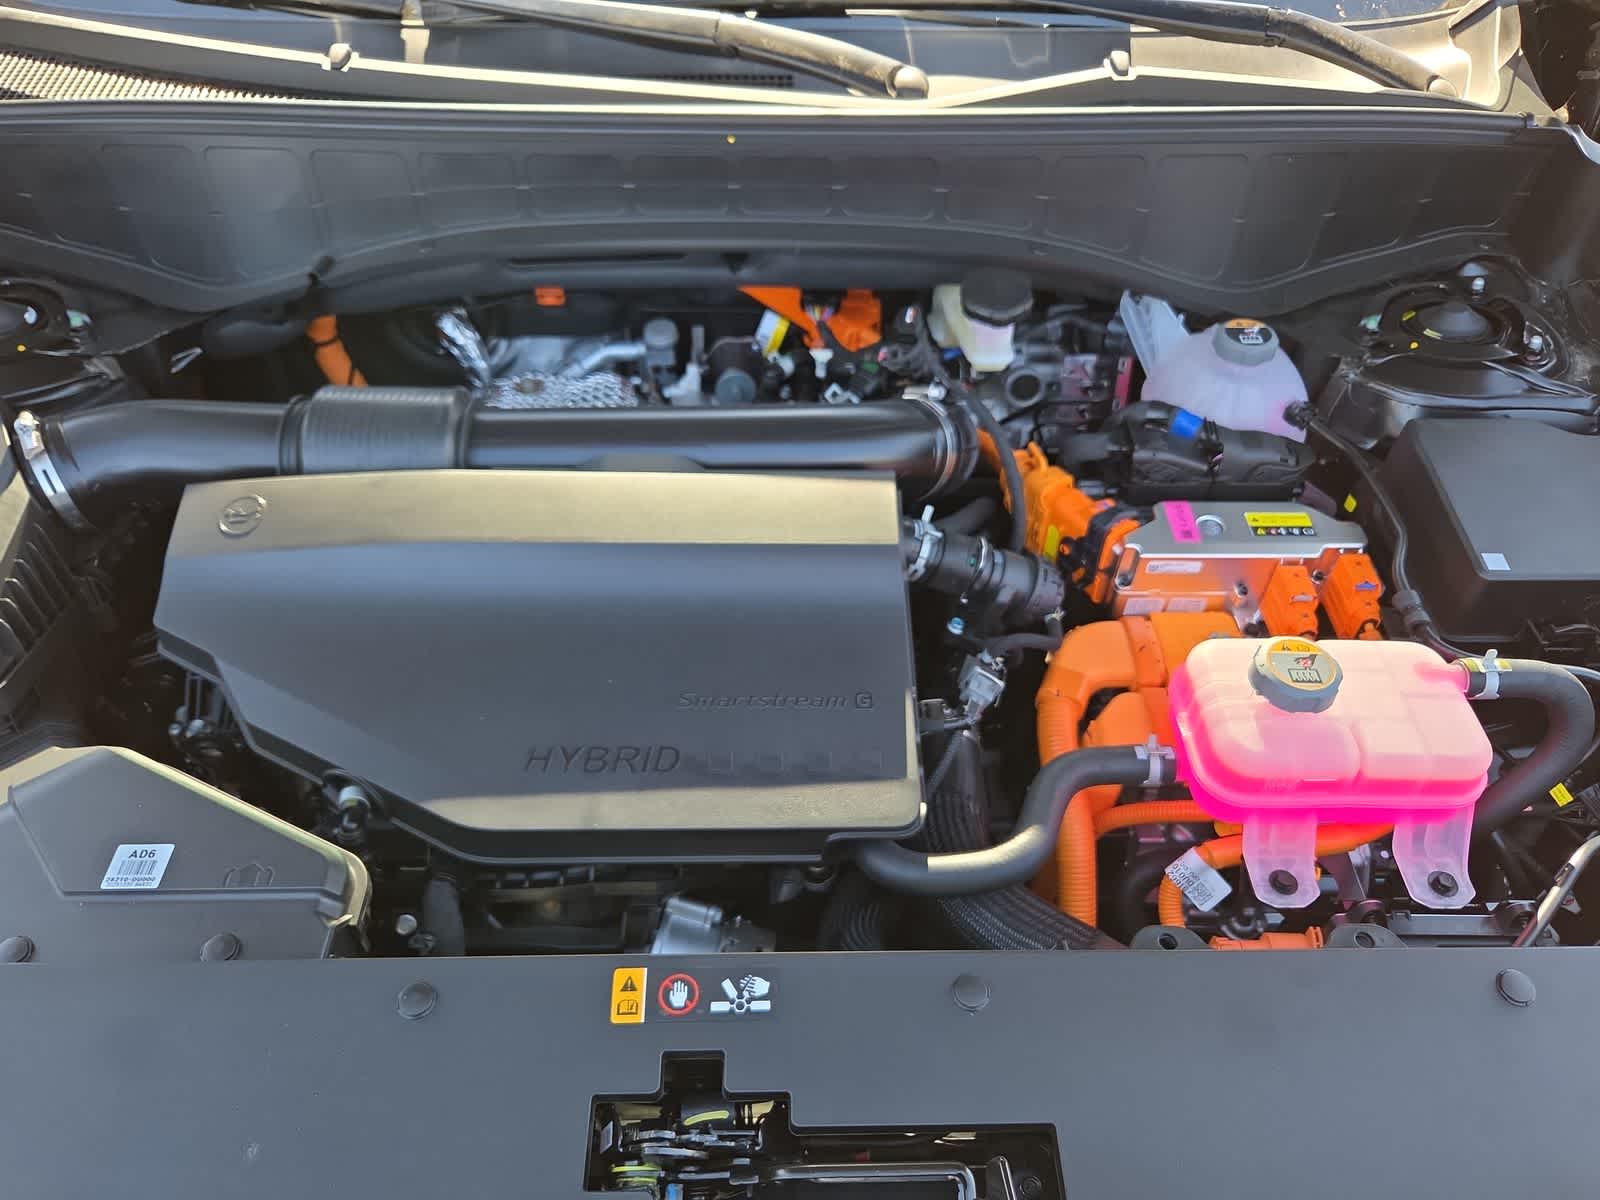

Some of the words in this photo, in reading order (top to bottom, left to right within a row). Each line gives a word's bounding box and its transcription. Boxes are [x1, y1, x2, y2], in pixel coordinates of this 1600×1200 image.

[678, 689, 848, 709] Smartstream
[523, 745, 681, 773] HYBRID
[128, 849, 157, 858] AD6
